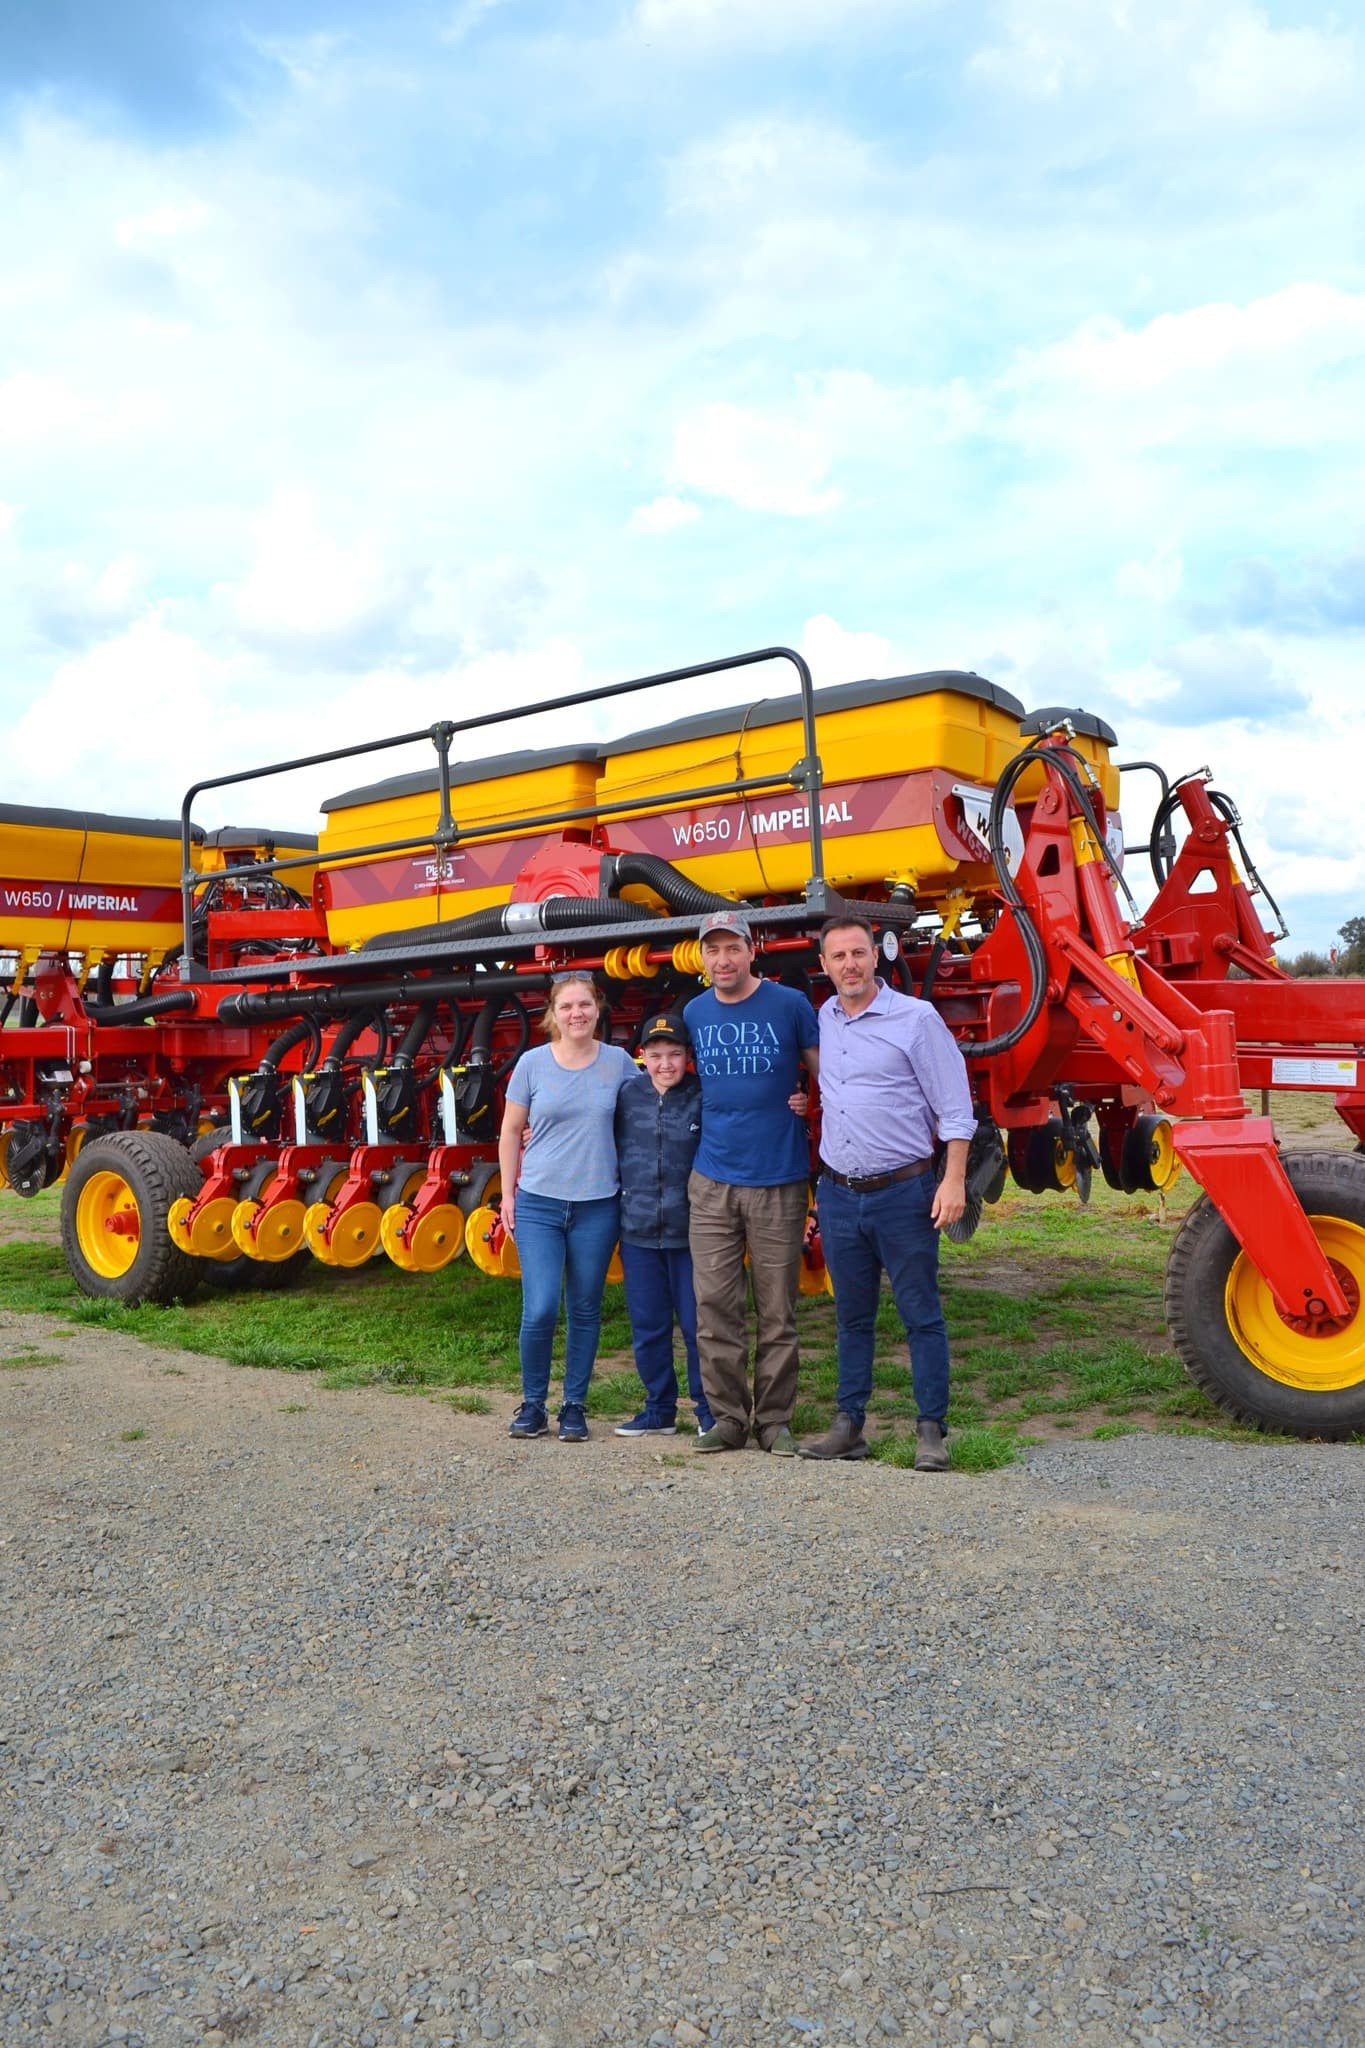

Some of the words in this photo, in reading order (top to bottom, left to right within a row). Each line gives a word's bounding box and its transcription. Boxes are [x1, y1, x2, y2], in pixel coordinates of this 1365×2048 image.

[672, 818, 731, 846] W650
[4, 890, 52, 908] W650
[68, 893, 138, 912] IMPERIAL
[735, 1045, 780, 1055] VIBES
[727, 1055, 774, 1075] LTD.
